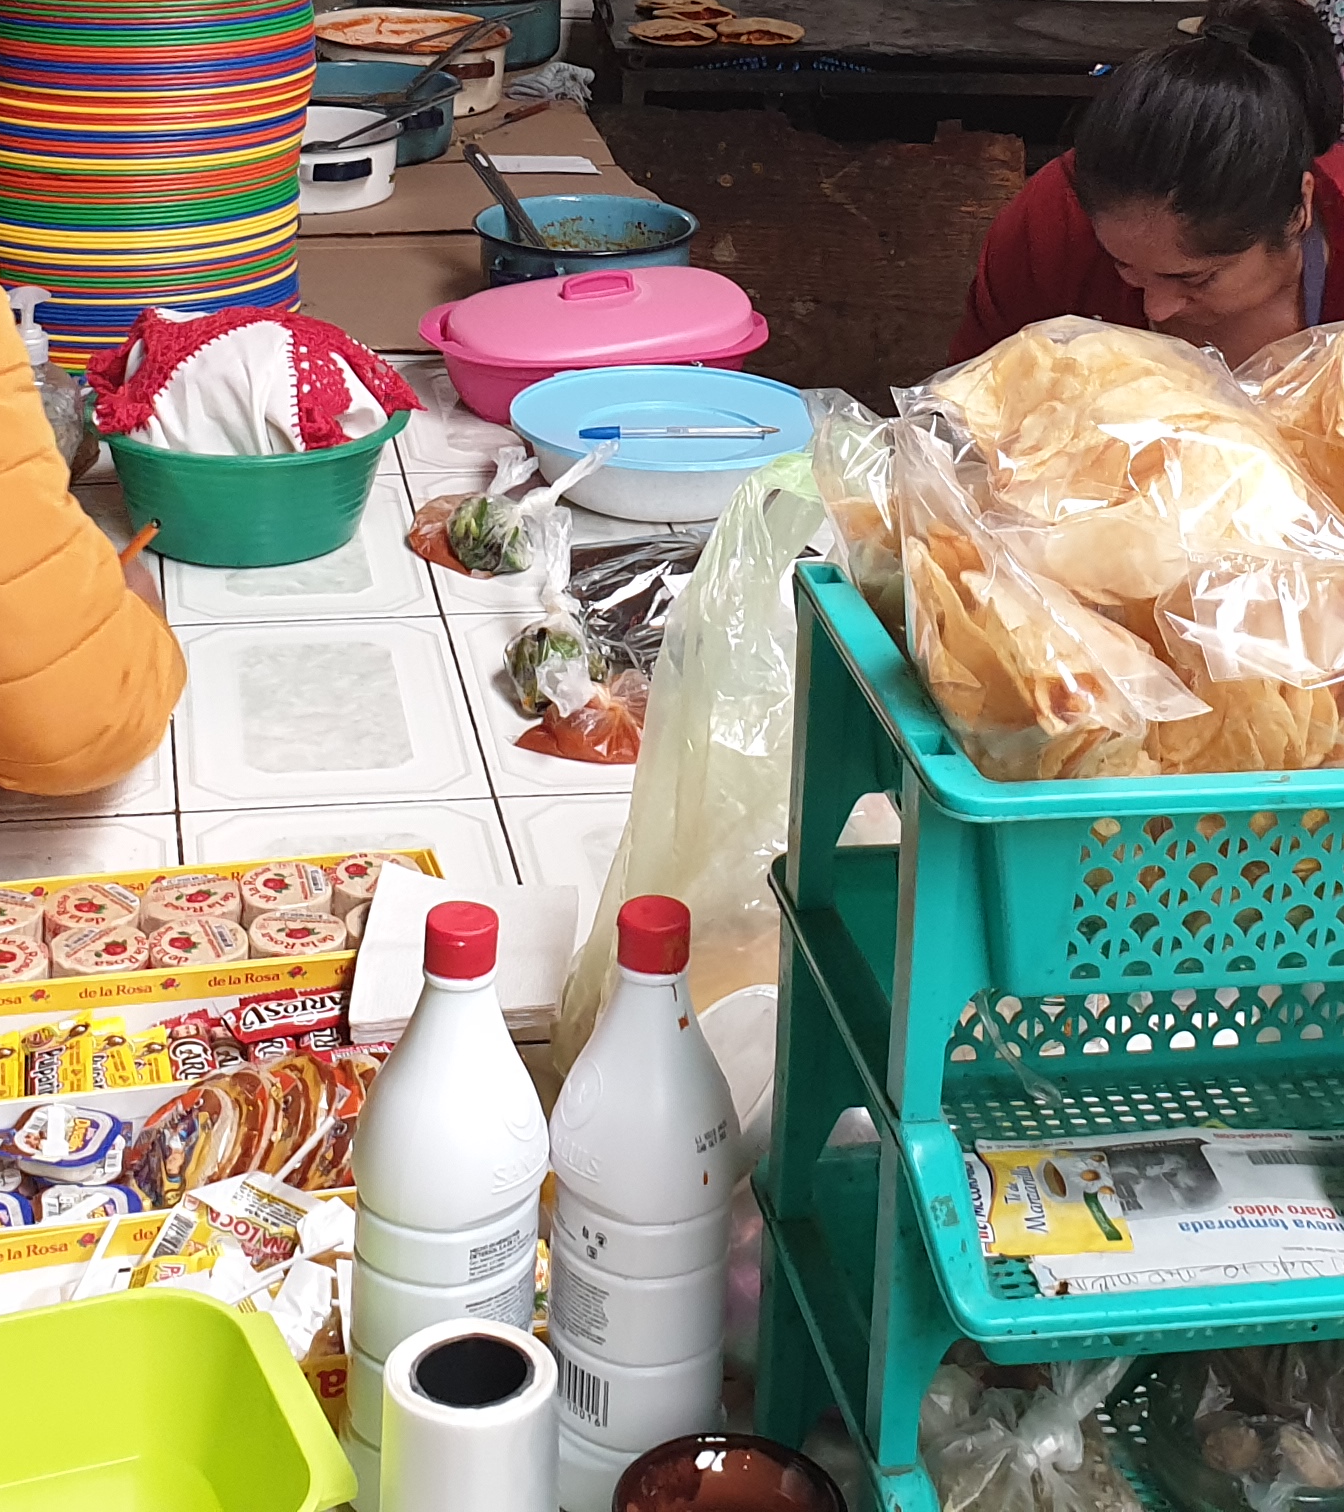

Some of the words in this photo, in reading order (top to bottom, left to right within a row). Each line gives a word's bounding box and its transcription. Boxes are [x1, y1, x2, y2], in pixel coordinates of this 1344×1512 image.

[208, 975, 227, 988] de
[228, 973, 241, 986] la
[244, 972, 281, 985] Rosa
[78, 987, 98, 1000] de
[100, 984, 113, 998] la
[116, 983, 153, 996] Rosa
[265, 994, 346, 1018] ARLOS
[1011, 1165, 1048, 1234] Manzanilla
[1228, 1203, 1285, 1217] video.
[1287, 1203, 1337, 1220] Claro
[1178, 1215, 1289, 1234] temporada
[133, 1227, 154, 1241] de
[7, 1246, 23, 1261] la
[26, 1241, 69, 1257] Rosa
